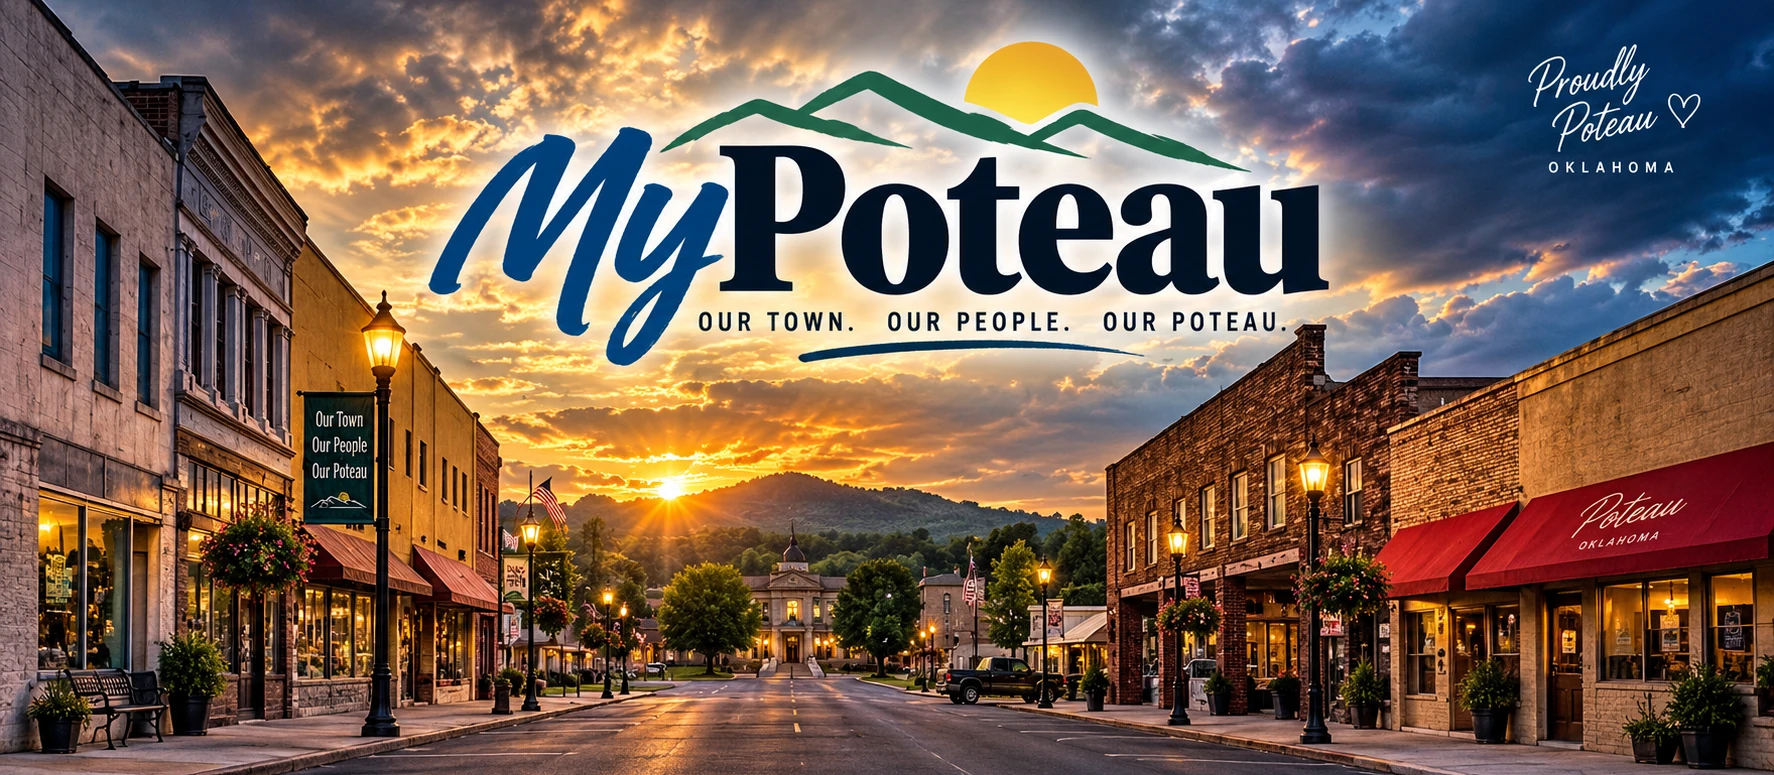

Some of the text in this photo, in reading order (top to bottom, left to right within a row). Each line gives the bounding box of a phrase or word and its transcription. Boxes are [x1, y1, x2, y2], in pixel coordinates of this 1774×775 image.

[316, 411, 363, 427] Our Town
[312, 436, 368, 456] Our People
[312, 463, 367, 479] Our Poteau
[1571, 492, 1687, 538] Poteau
[1578, 531, 1660, 550] OKLAHOMA
